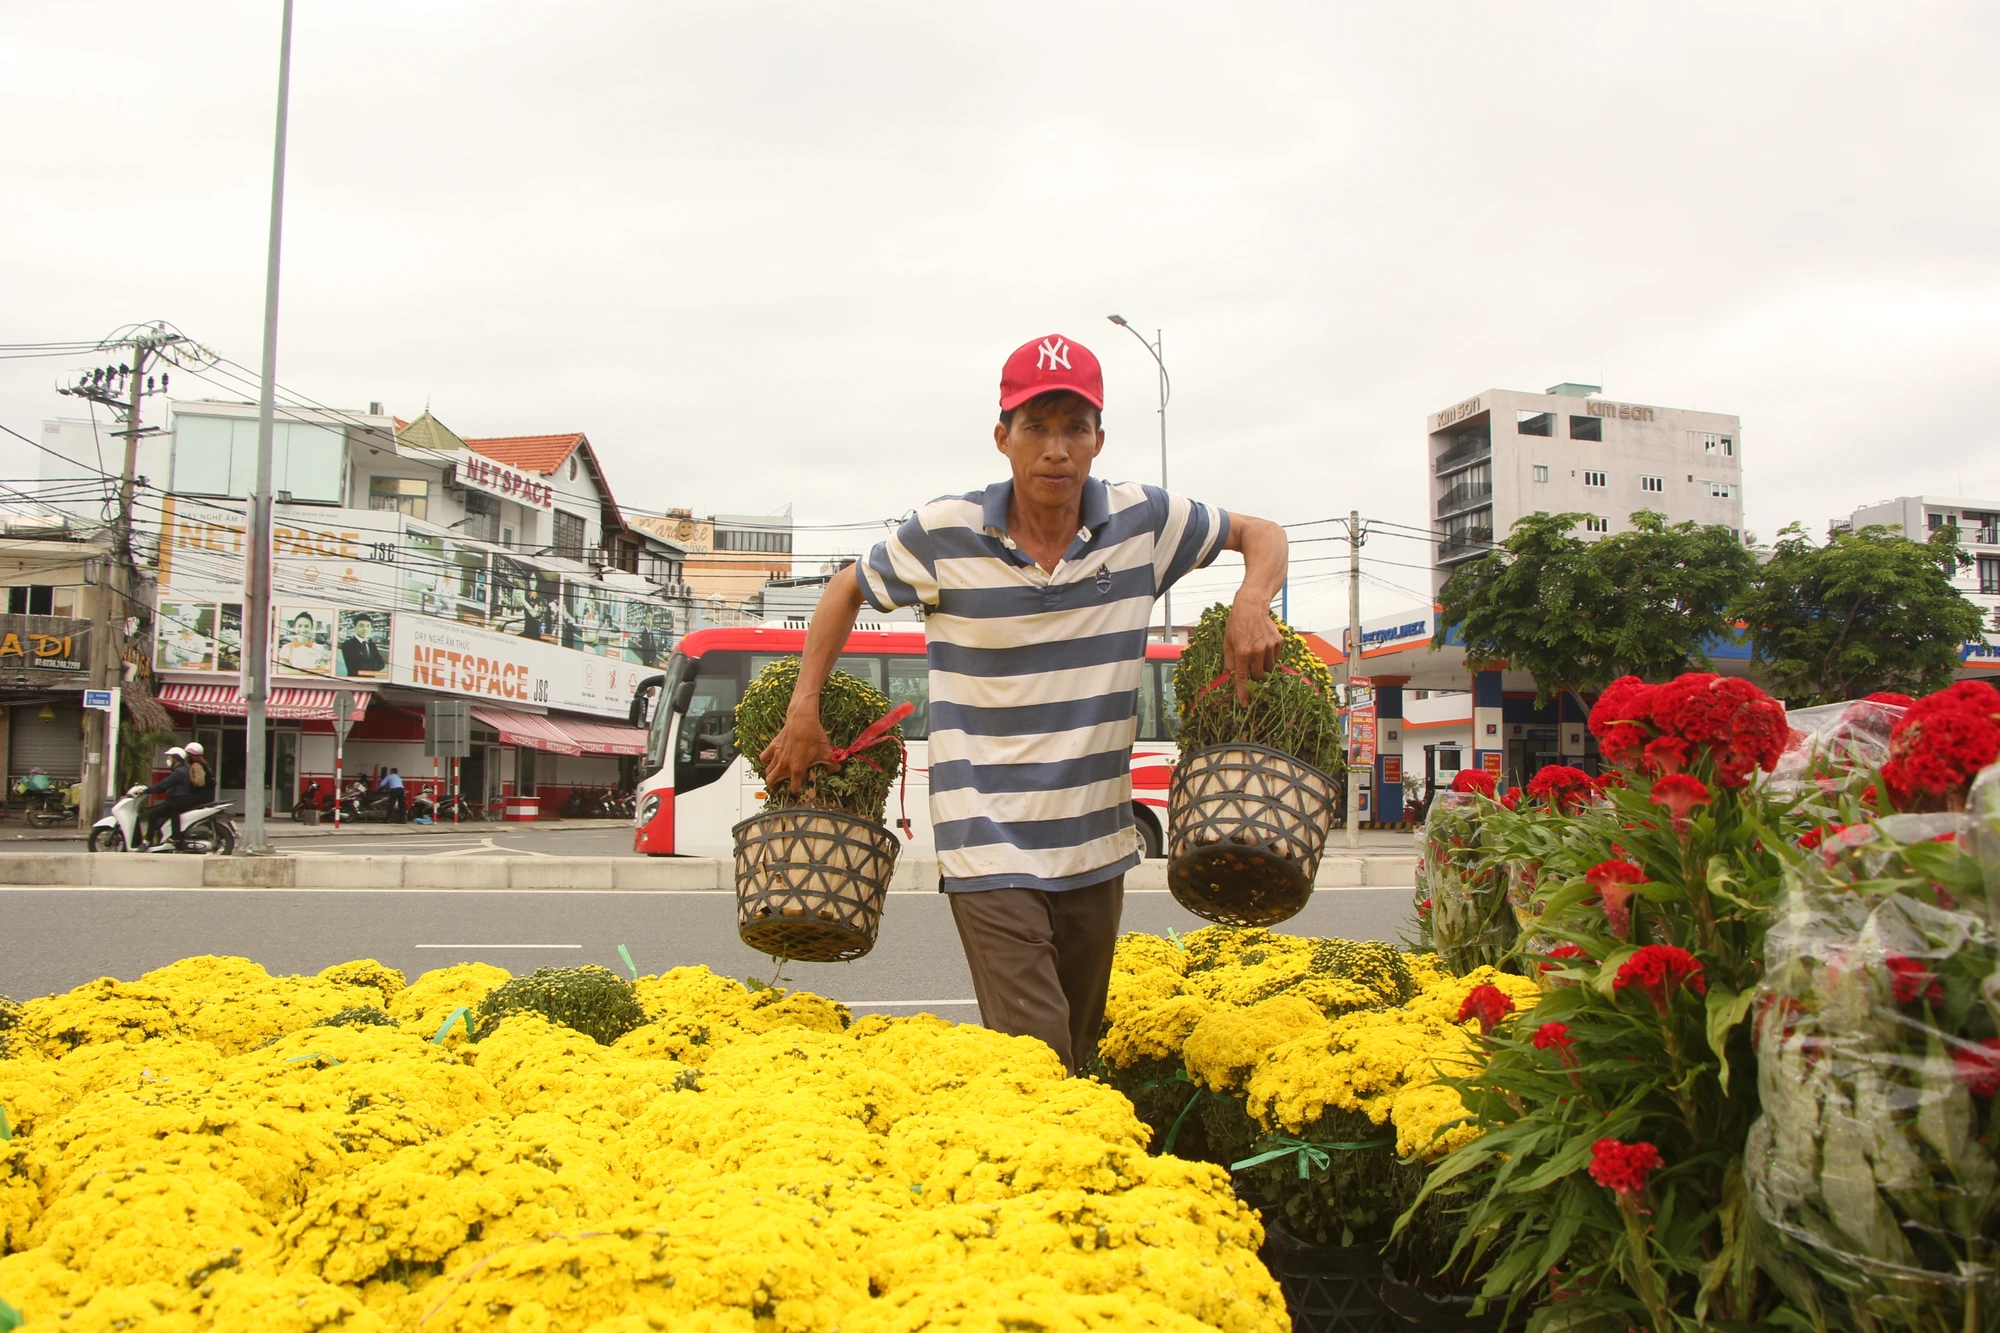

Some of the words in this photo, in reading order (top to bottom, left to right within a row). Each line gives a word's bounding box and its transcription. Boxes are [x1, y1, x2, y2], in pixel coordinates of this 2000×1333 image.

[466, 456, 553, 508] NETSPACE
[178, 521, 360, 558] NETPACE
[370, 542, 395, 562] JSC
[1362, 620, 1426, 643] PETROLIMEX
[412, 644, 529, 701] NETSPACE
[533, 678, 549, 703] JSC
[178, 704, 245, 716] NETSPACE
[268, 707, 335, 719] NETSPACE
